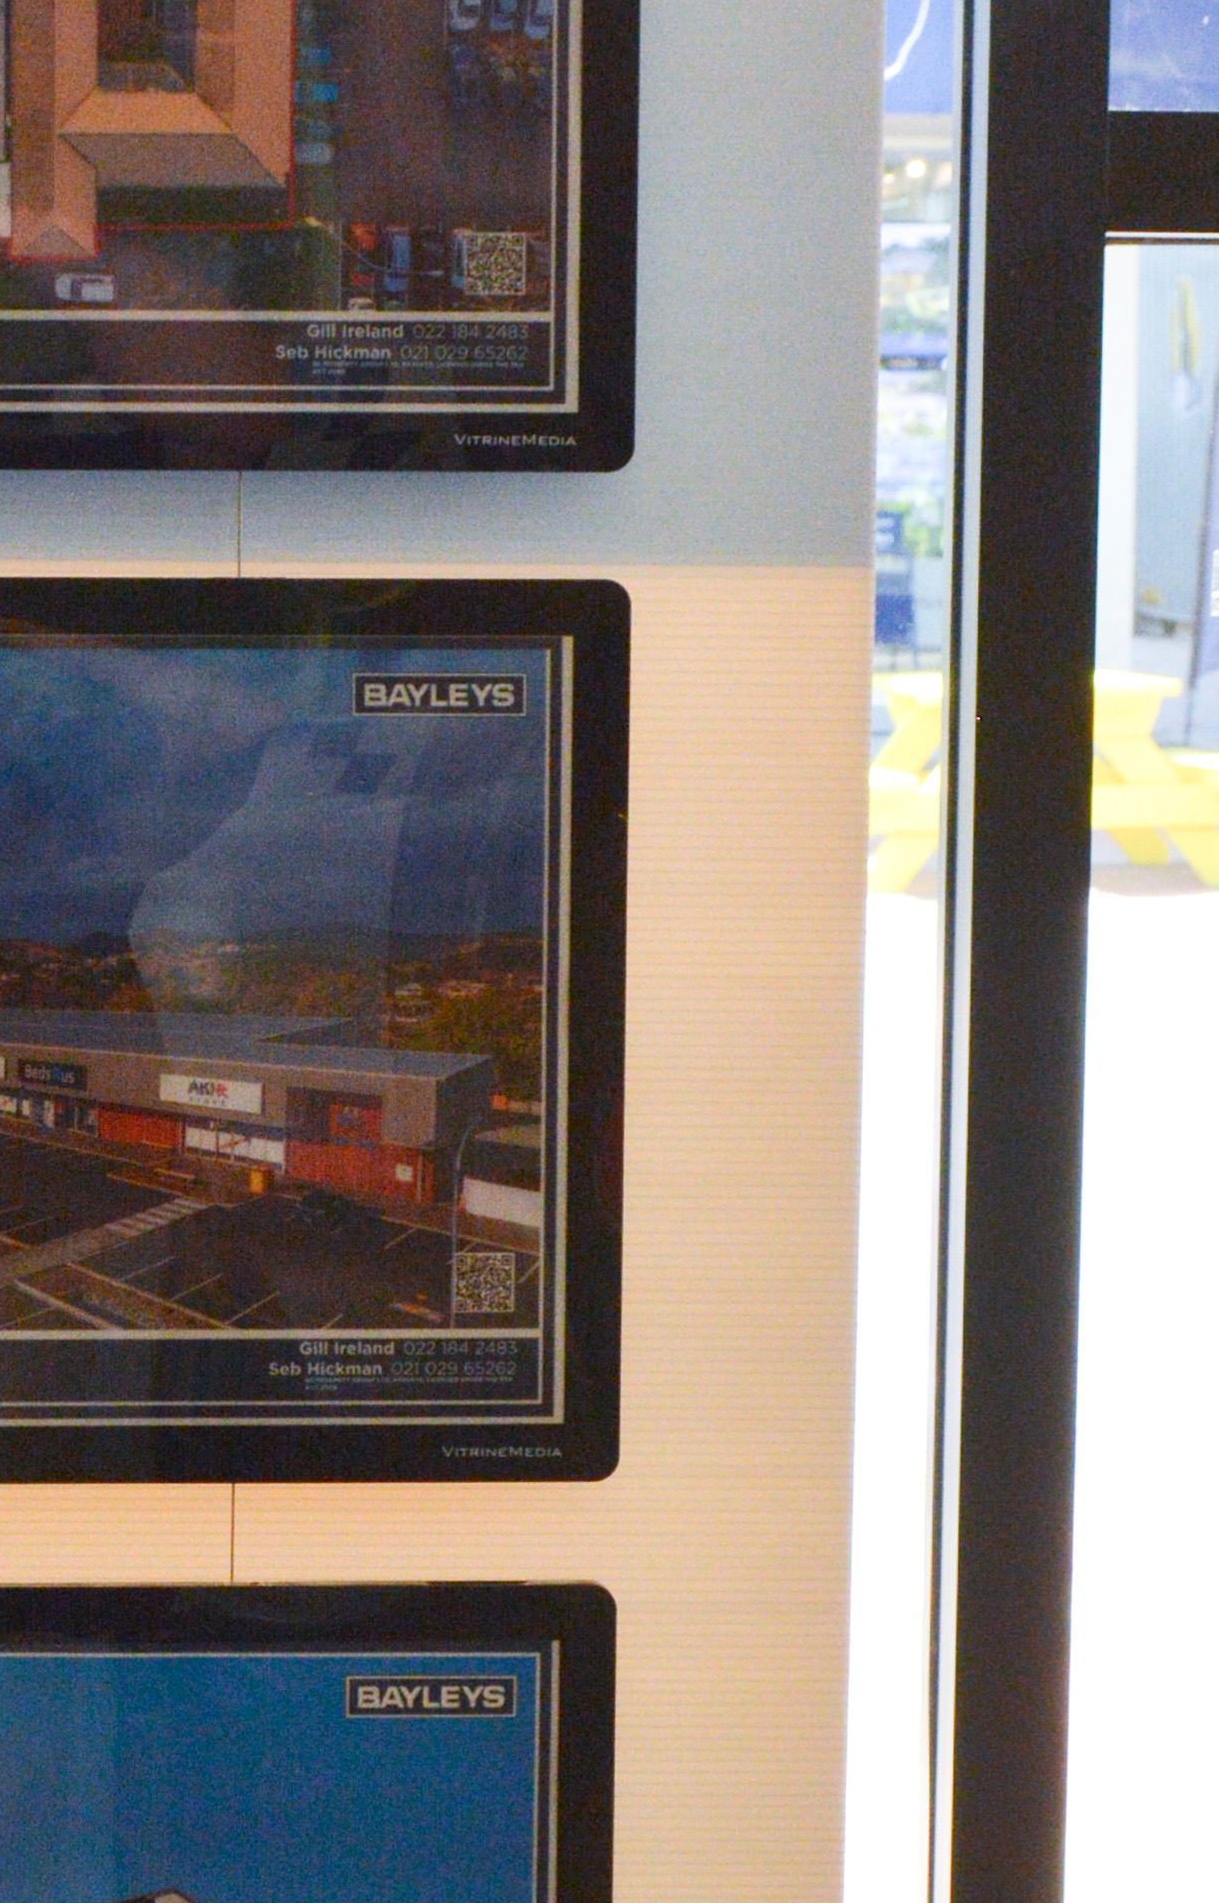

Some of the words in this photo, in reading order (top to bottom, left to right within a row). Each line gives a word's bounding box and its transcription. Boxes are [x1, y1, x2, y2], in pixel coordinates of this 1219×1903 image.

[306, 324, 336, 338] Gill
[342, 324, 404, 339] Ireland
[412, 325, 446, 339] 022
[453, 325, 479, 339] 184
[485, 325, 528, 339] 2483
[275, 345, 309, 360] Seb
[315, 345, 392, 360] Hickman
[400, 345, 429, 360] 021
[435, 345, 469, 360] 029
[474, 345, 527, 360] 65262
[364, 682, 515, 707] BAYLEYS
[299, 1341, 328, 1355] Gill
[334, 1341, 395, 1356] Ireland
[403, 1341, 434, 1356] 022
[442, 1341, 468, 1356] 184
[475, 1341, 518, 1356] 2483
[268, 1362, 301, 1376] Seb
[307, 1362, 383, 1376] Hickman
[391, 1362, 419, 1376] 021
[425, 1362, 458, 1376] 029
[463, 1362, 517, 1376] 65262
[357, 1686, 506, 1709] BAYLEYS
